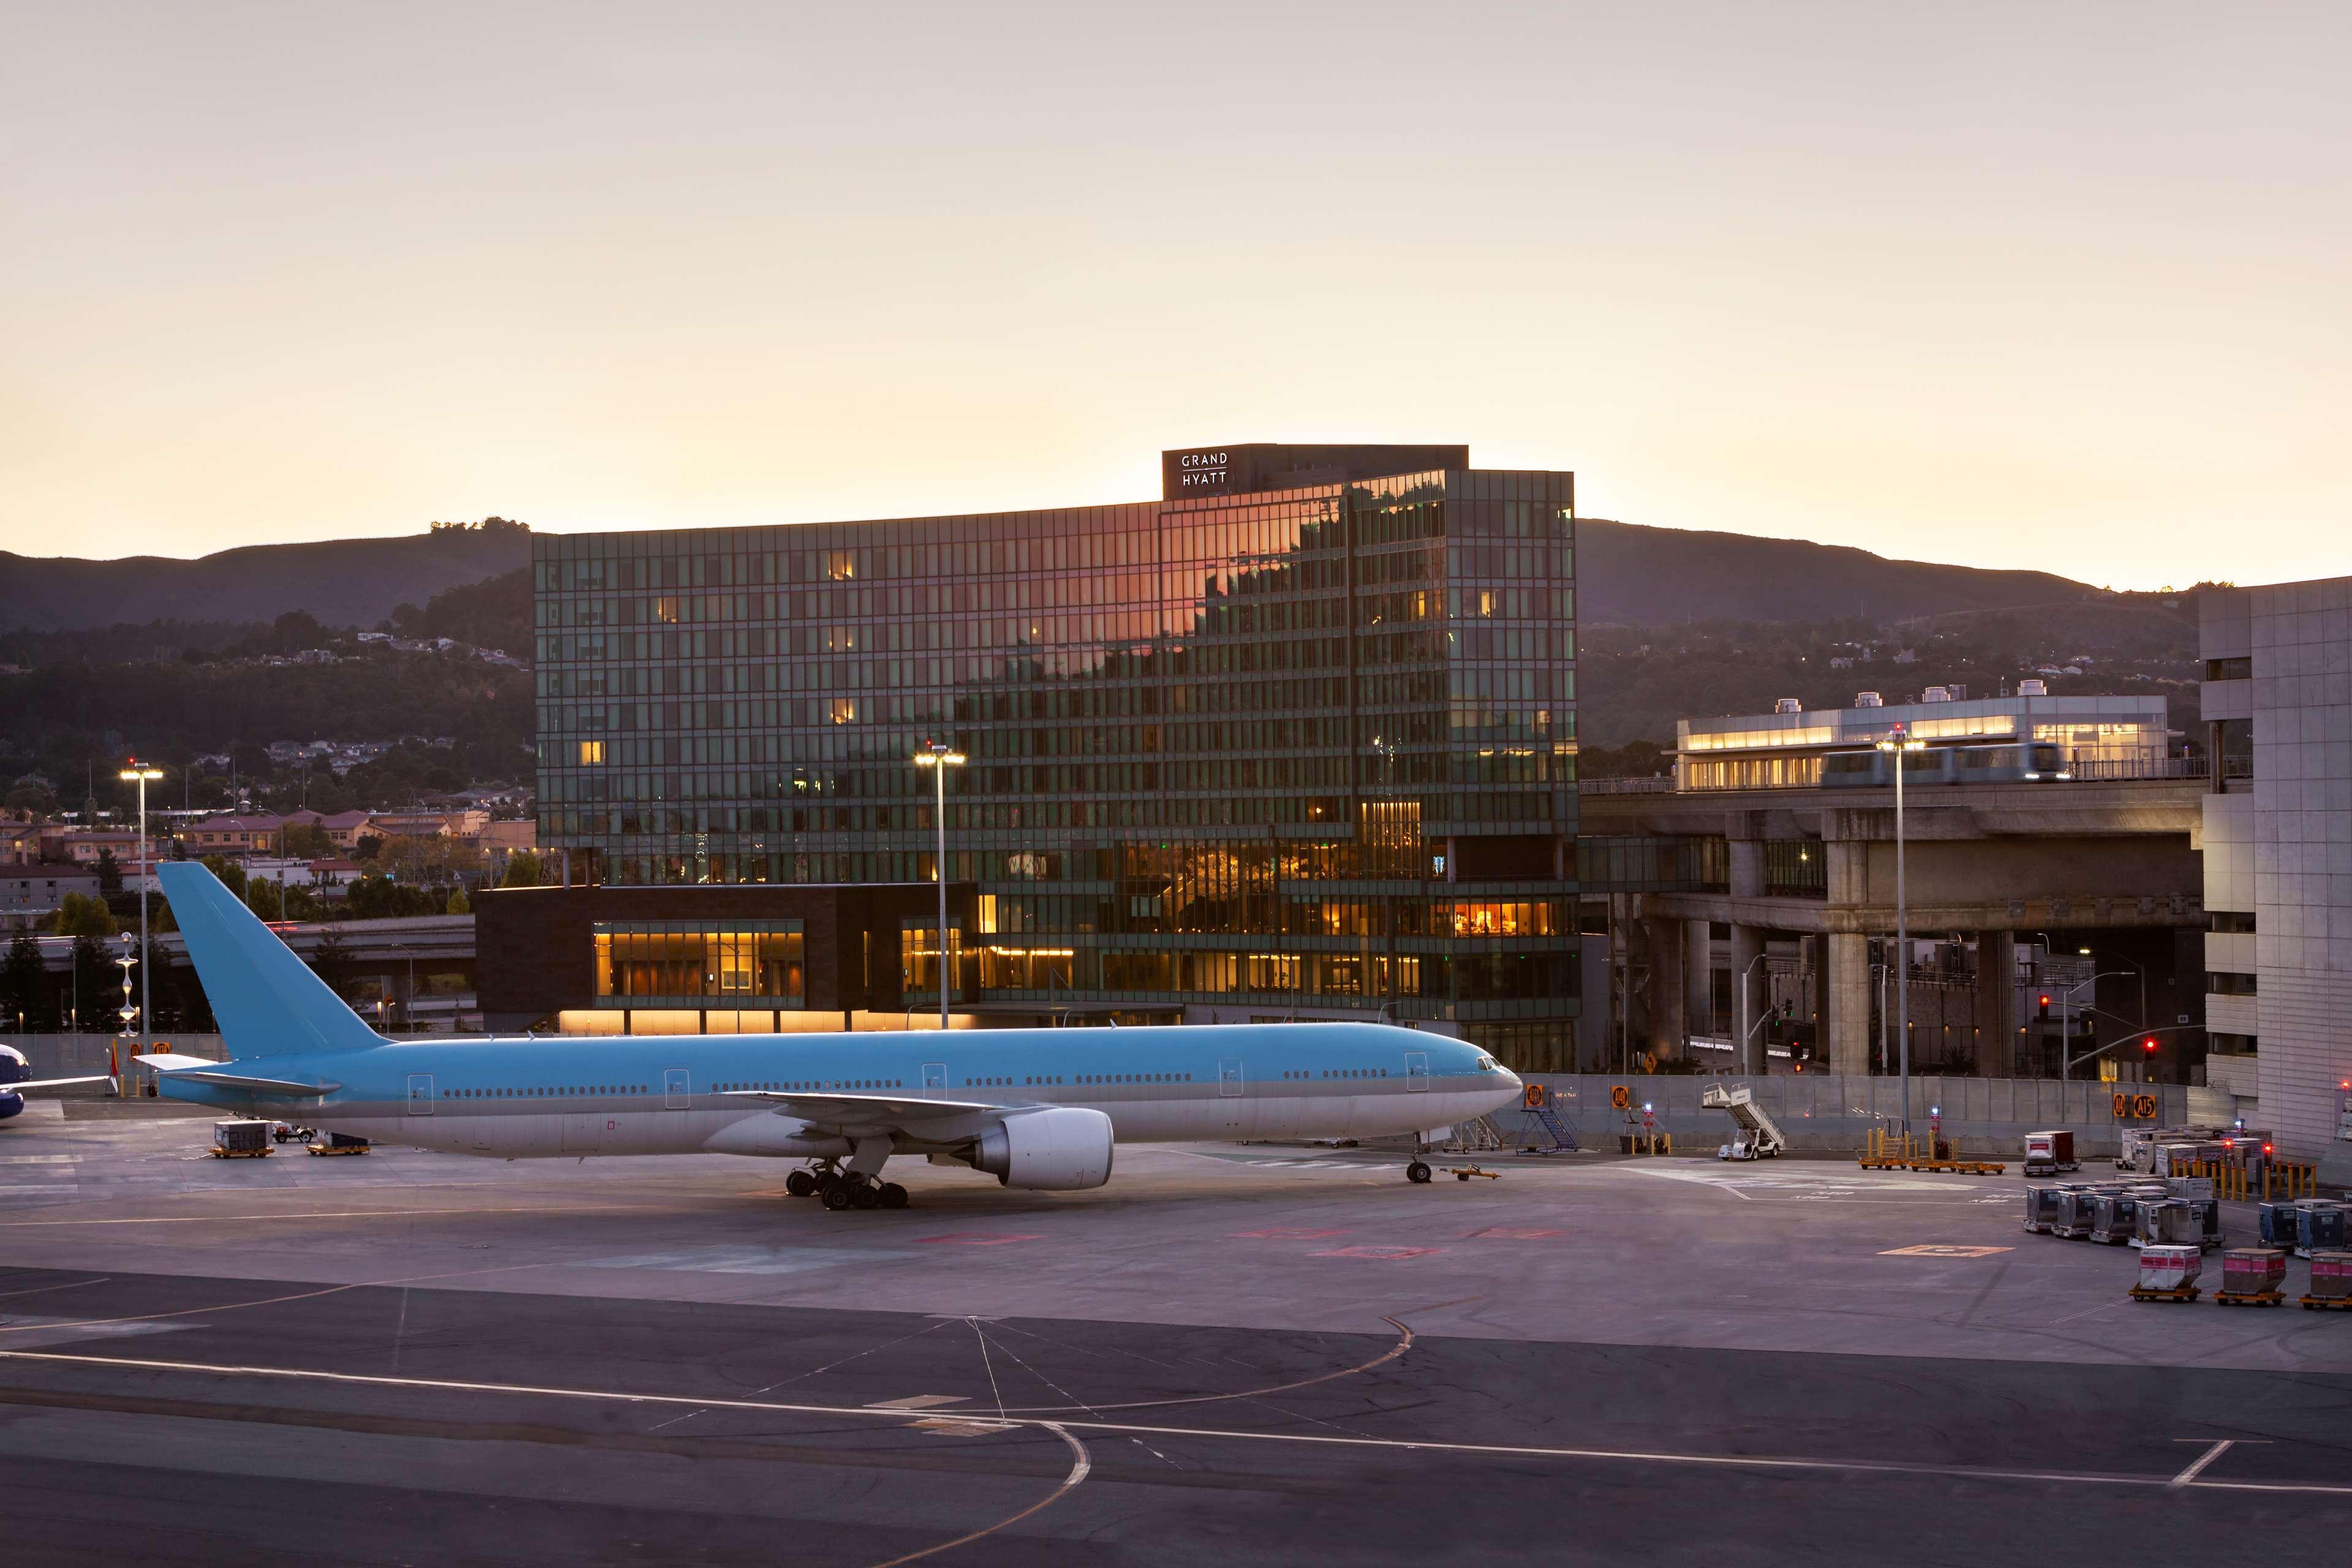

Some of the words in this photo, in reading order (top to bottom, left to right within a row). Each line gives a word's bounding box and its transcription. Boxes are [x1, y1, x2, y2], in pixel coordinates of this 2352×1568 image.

[1182, 453, 1227, 467] GRAND
[1183, 472, 1226, 486] HYATT
[1615, 1089, 1626, 1105] A14B
[2137, 1098, 2152, 1114] A15
